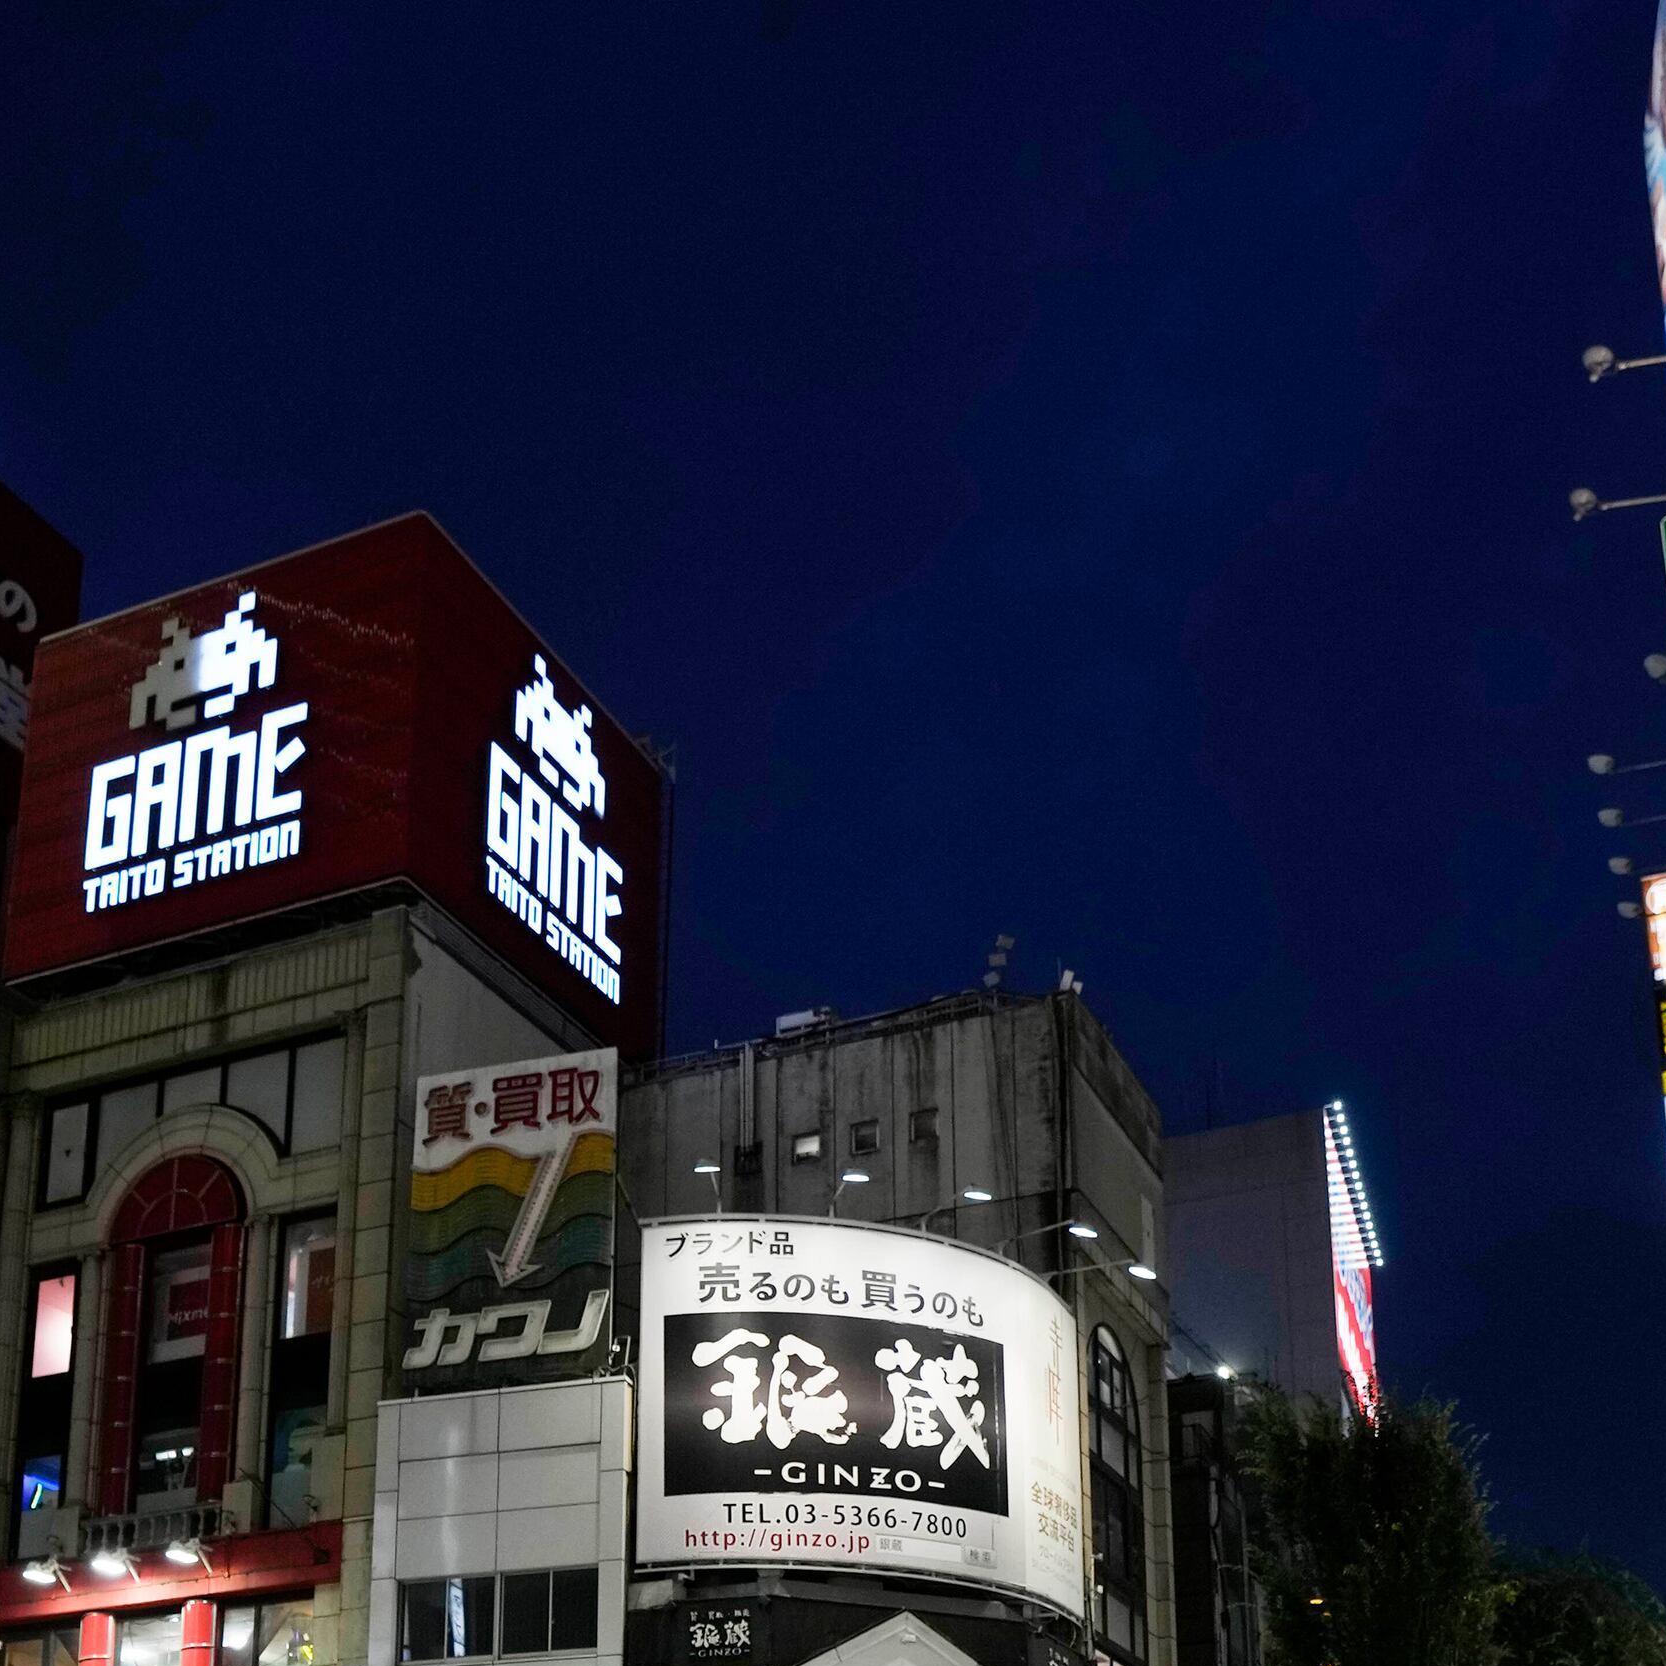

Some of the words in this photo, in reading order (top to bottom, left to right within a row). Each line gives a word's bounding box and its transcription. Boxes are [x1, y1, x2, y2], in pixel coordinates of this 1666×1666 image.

[85, 702, 308, 870] GAME
[83, 856, 167, 913] TAITO
[173, 820, 301, 889] STATION
[486, 740, 623, 966] GAME
[486, 855, 543, 937] TAITO
[546, 915, 621, 1005] STATION
[422, 1067, 600, 1147] 質・買取
[664, 1229, 795, 1258] ブランド品
[697, 1262, 985, 1328] 売るのも買うのも
[691, 1327, 991, 1470] 銀蔵
[685, 1528, 870, 1554] http://ginzo.jp
[723, 1502, 968, 1539] TEL.03-5366-7800
